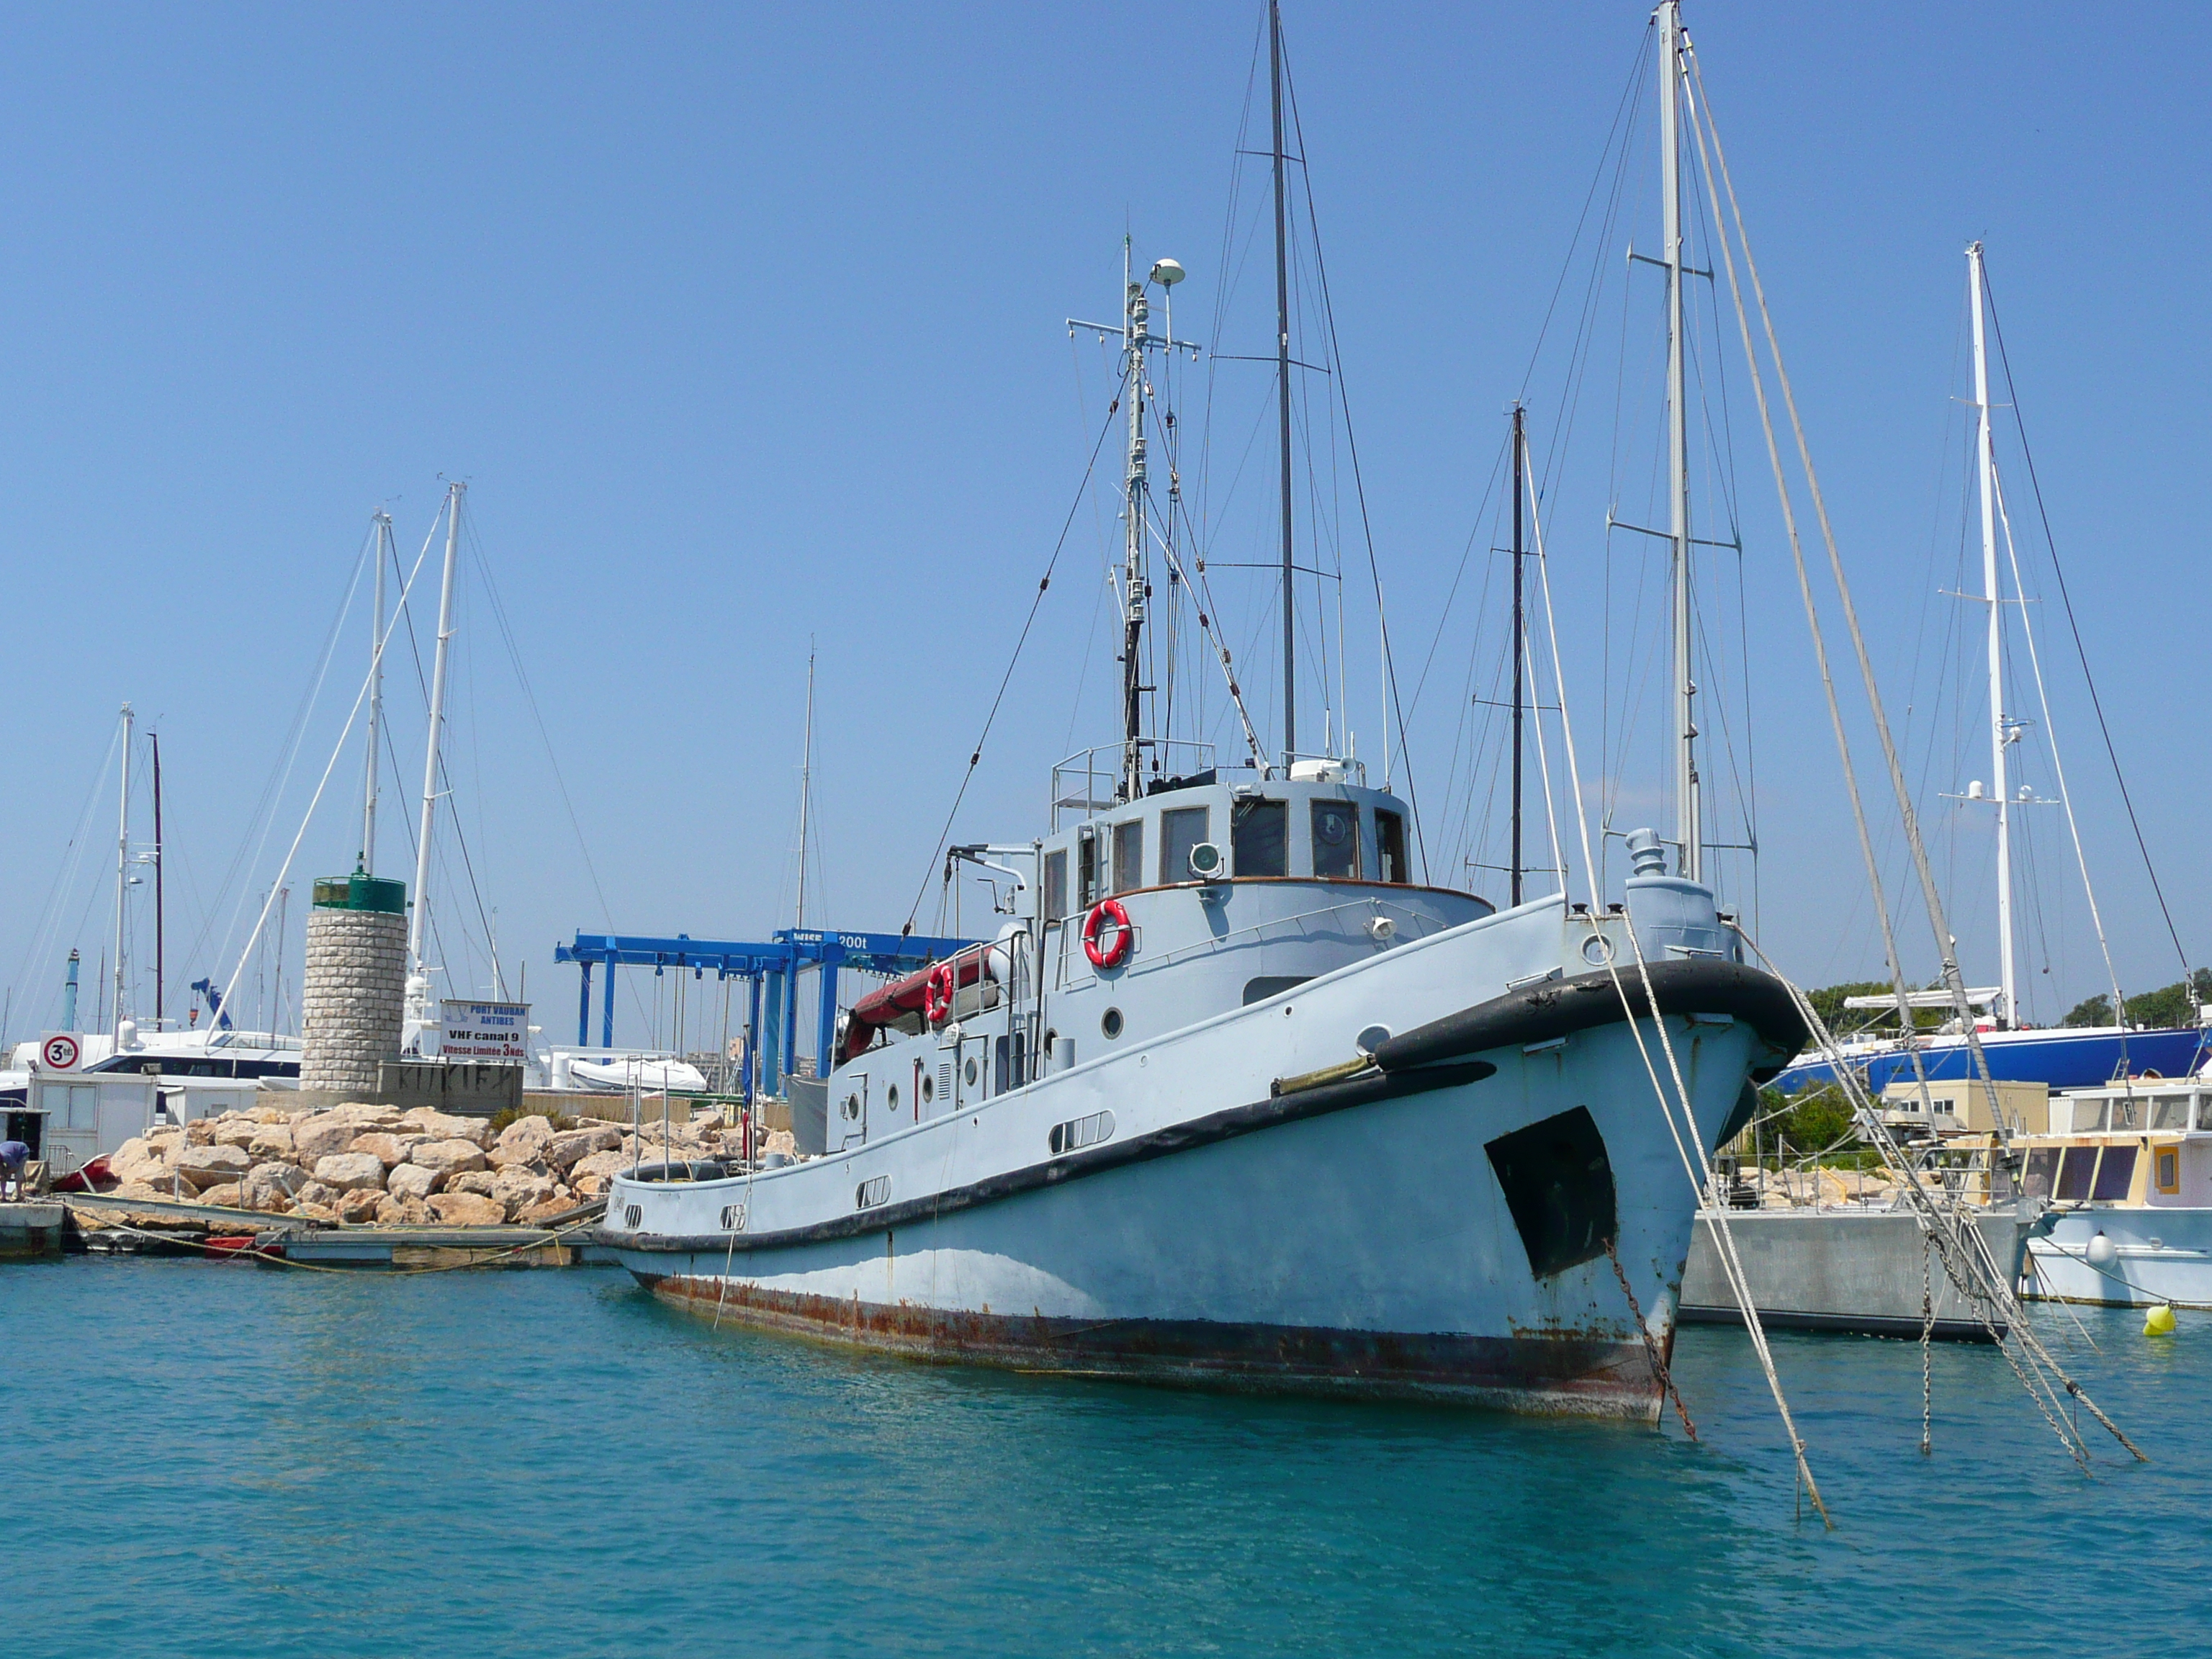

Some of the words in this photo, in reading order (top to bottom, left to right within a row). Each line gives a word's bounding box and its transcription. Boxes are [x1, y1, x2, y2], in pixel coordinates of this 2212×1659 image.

[839, 936, 867, 949] 200t
[470, 1005, 491, 1015] PORT
[493, 1006, 526, 1016] VAUBAN
[480, 1016, 515, 1025] ANTIBES
[449, 1030, 472, 1039] VHF
[474, 1032, 508, 1041] canal
[511, 1033, 519, 1042] 9
[443, 1045, 472, 1055] Vitesse
[473, 1046, 501, 1056] Limitée
